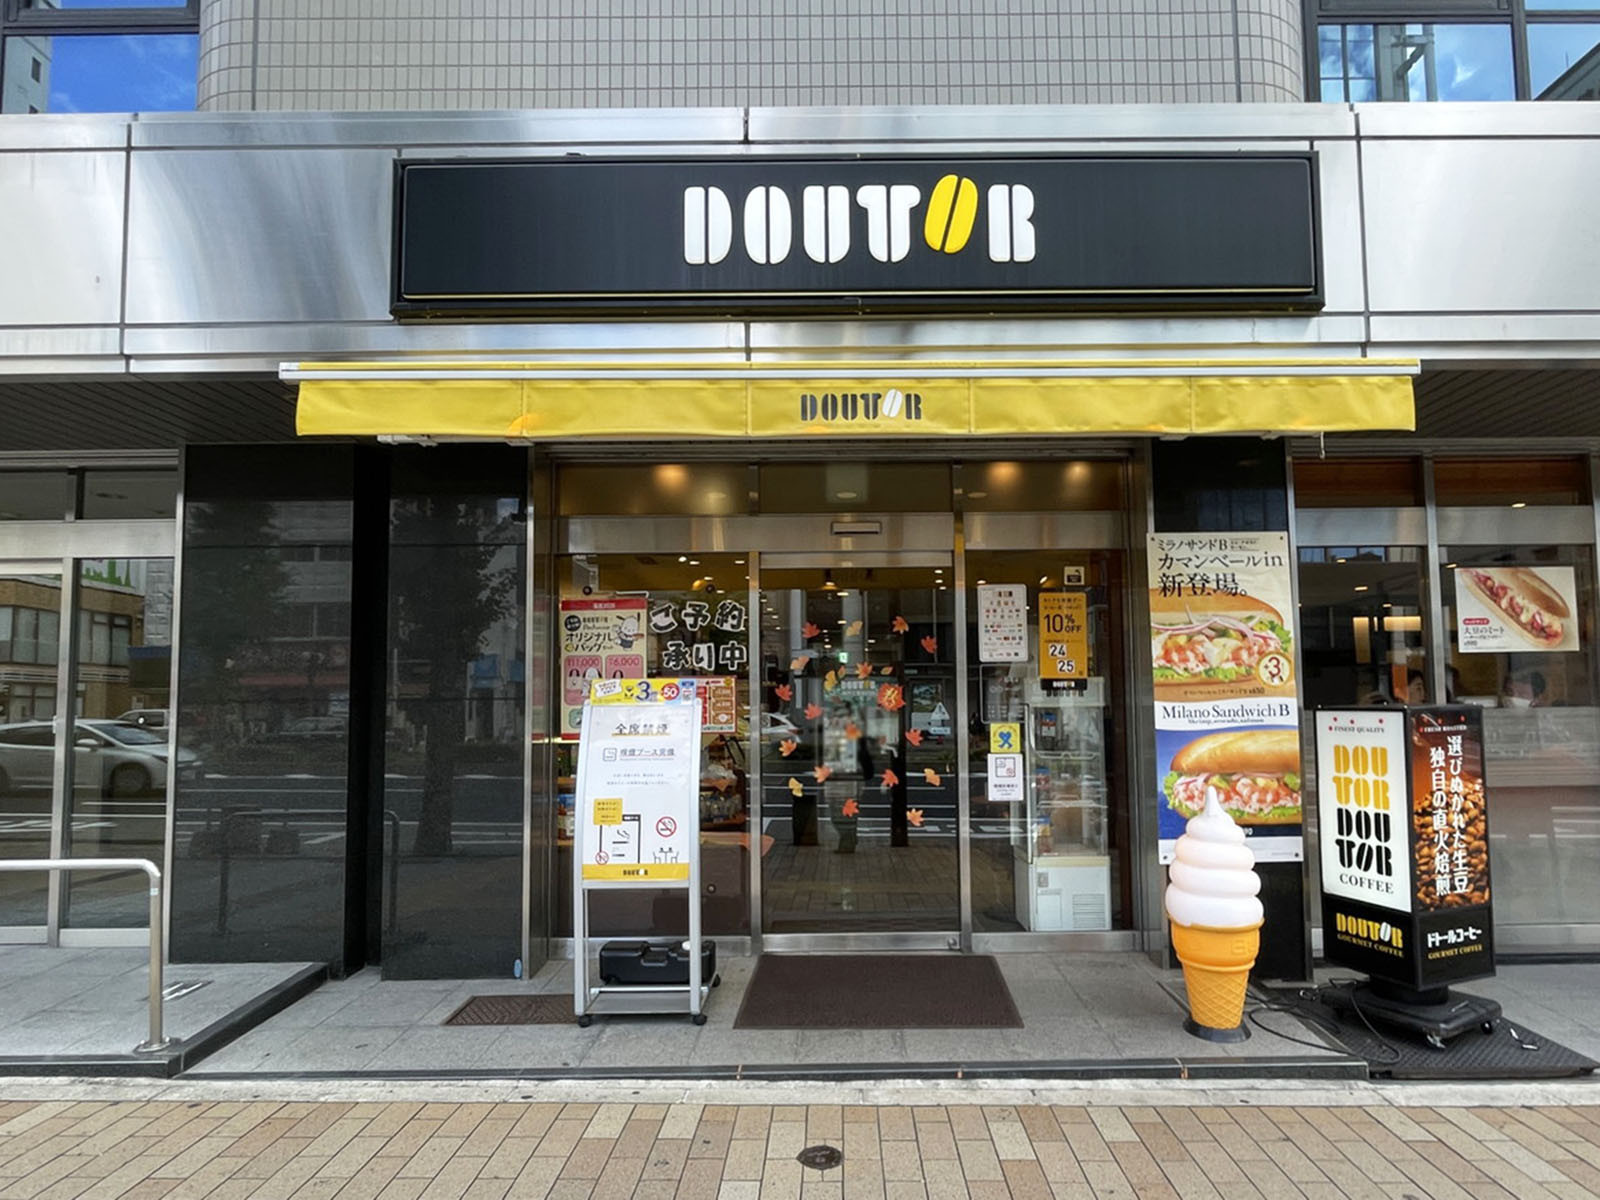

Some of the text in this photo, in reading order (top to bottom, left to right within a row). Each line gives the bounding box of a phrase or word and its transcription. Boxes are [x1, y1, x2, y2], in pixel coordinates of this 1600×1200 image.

[684, 174, 1036, 264] DOUTOR
[800, 389, 921, 420] DOUTOR
[1158, 539, 1227, 551] ミラノサンドB
[1158, 551, 1283, 570] カマンベールin
[1158, 573, 1247, 598] 新登場。
[650, 600, 746, 633] ご予約
[566, 633, 614, 642] オリジナル
[662, 641, 747, 671] 承り中
[1058, 660, 1074, 672] 25
[663, 687, 677, 698] 50
[1163, 703, 1290, 719] Milano Sandwich B
[1334, 725, 1355, 733] FINEST
[1333, 744, 1388, 777] DOU
[1332, 776, 1390, 811] TOR
[1337, 807, 1391, 843] DOU
[1430, 746, 1451, 897] 独自の直火焙煎
[1447, 735, 1469, 893] 選びぬかれた生豆
[1335, 838, 1393, 877] TOR
[1339, 872, 1394, 894] COFFEE
[1335, 912, 1403, 949] DOUTOR
[1427, 926, 1482, 948] ドトールコーヒー
[1337, 933, 1404, 958] GOURMET COFFEE
[1428, 944, 1483, 960] GOURMET COFFEE
